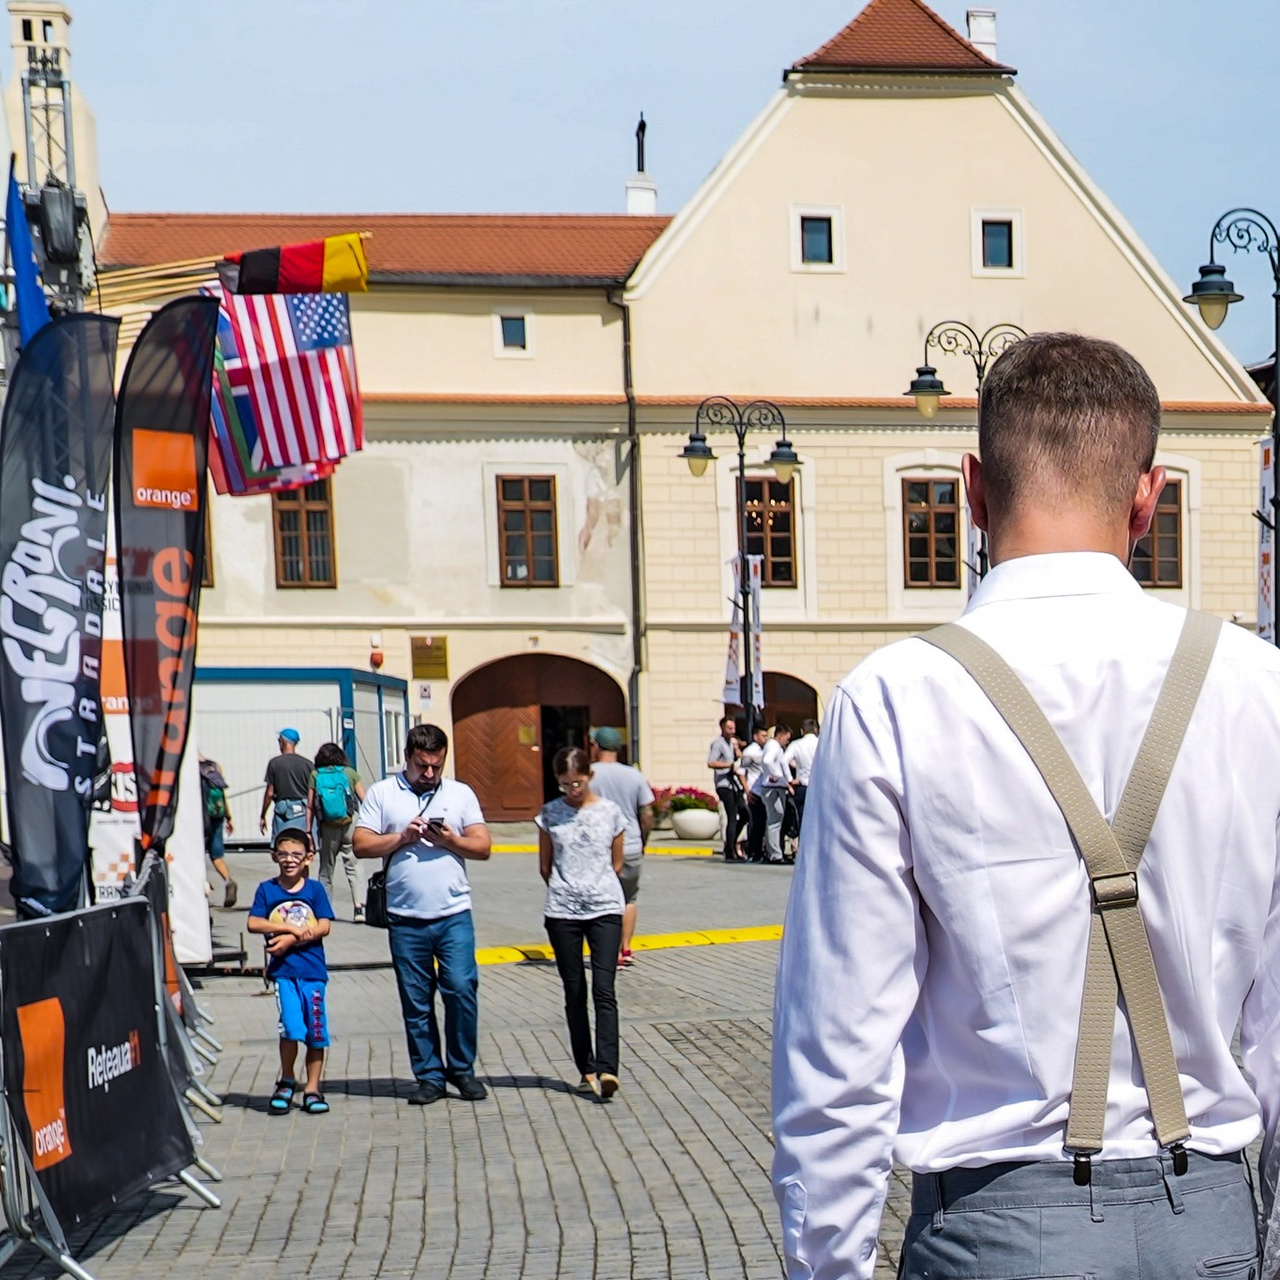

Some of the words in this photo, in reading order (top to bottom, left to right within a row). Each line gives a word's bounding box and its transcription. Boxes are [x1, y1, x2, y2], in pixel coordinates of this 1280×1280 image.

[136, 487, 192, 509] orange
[75, 488, 105, 796] STRADALE
[143, 547, 196, 849] ange
[35, 1118, 65, 1157] orange
